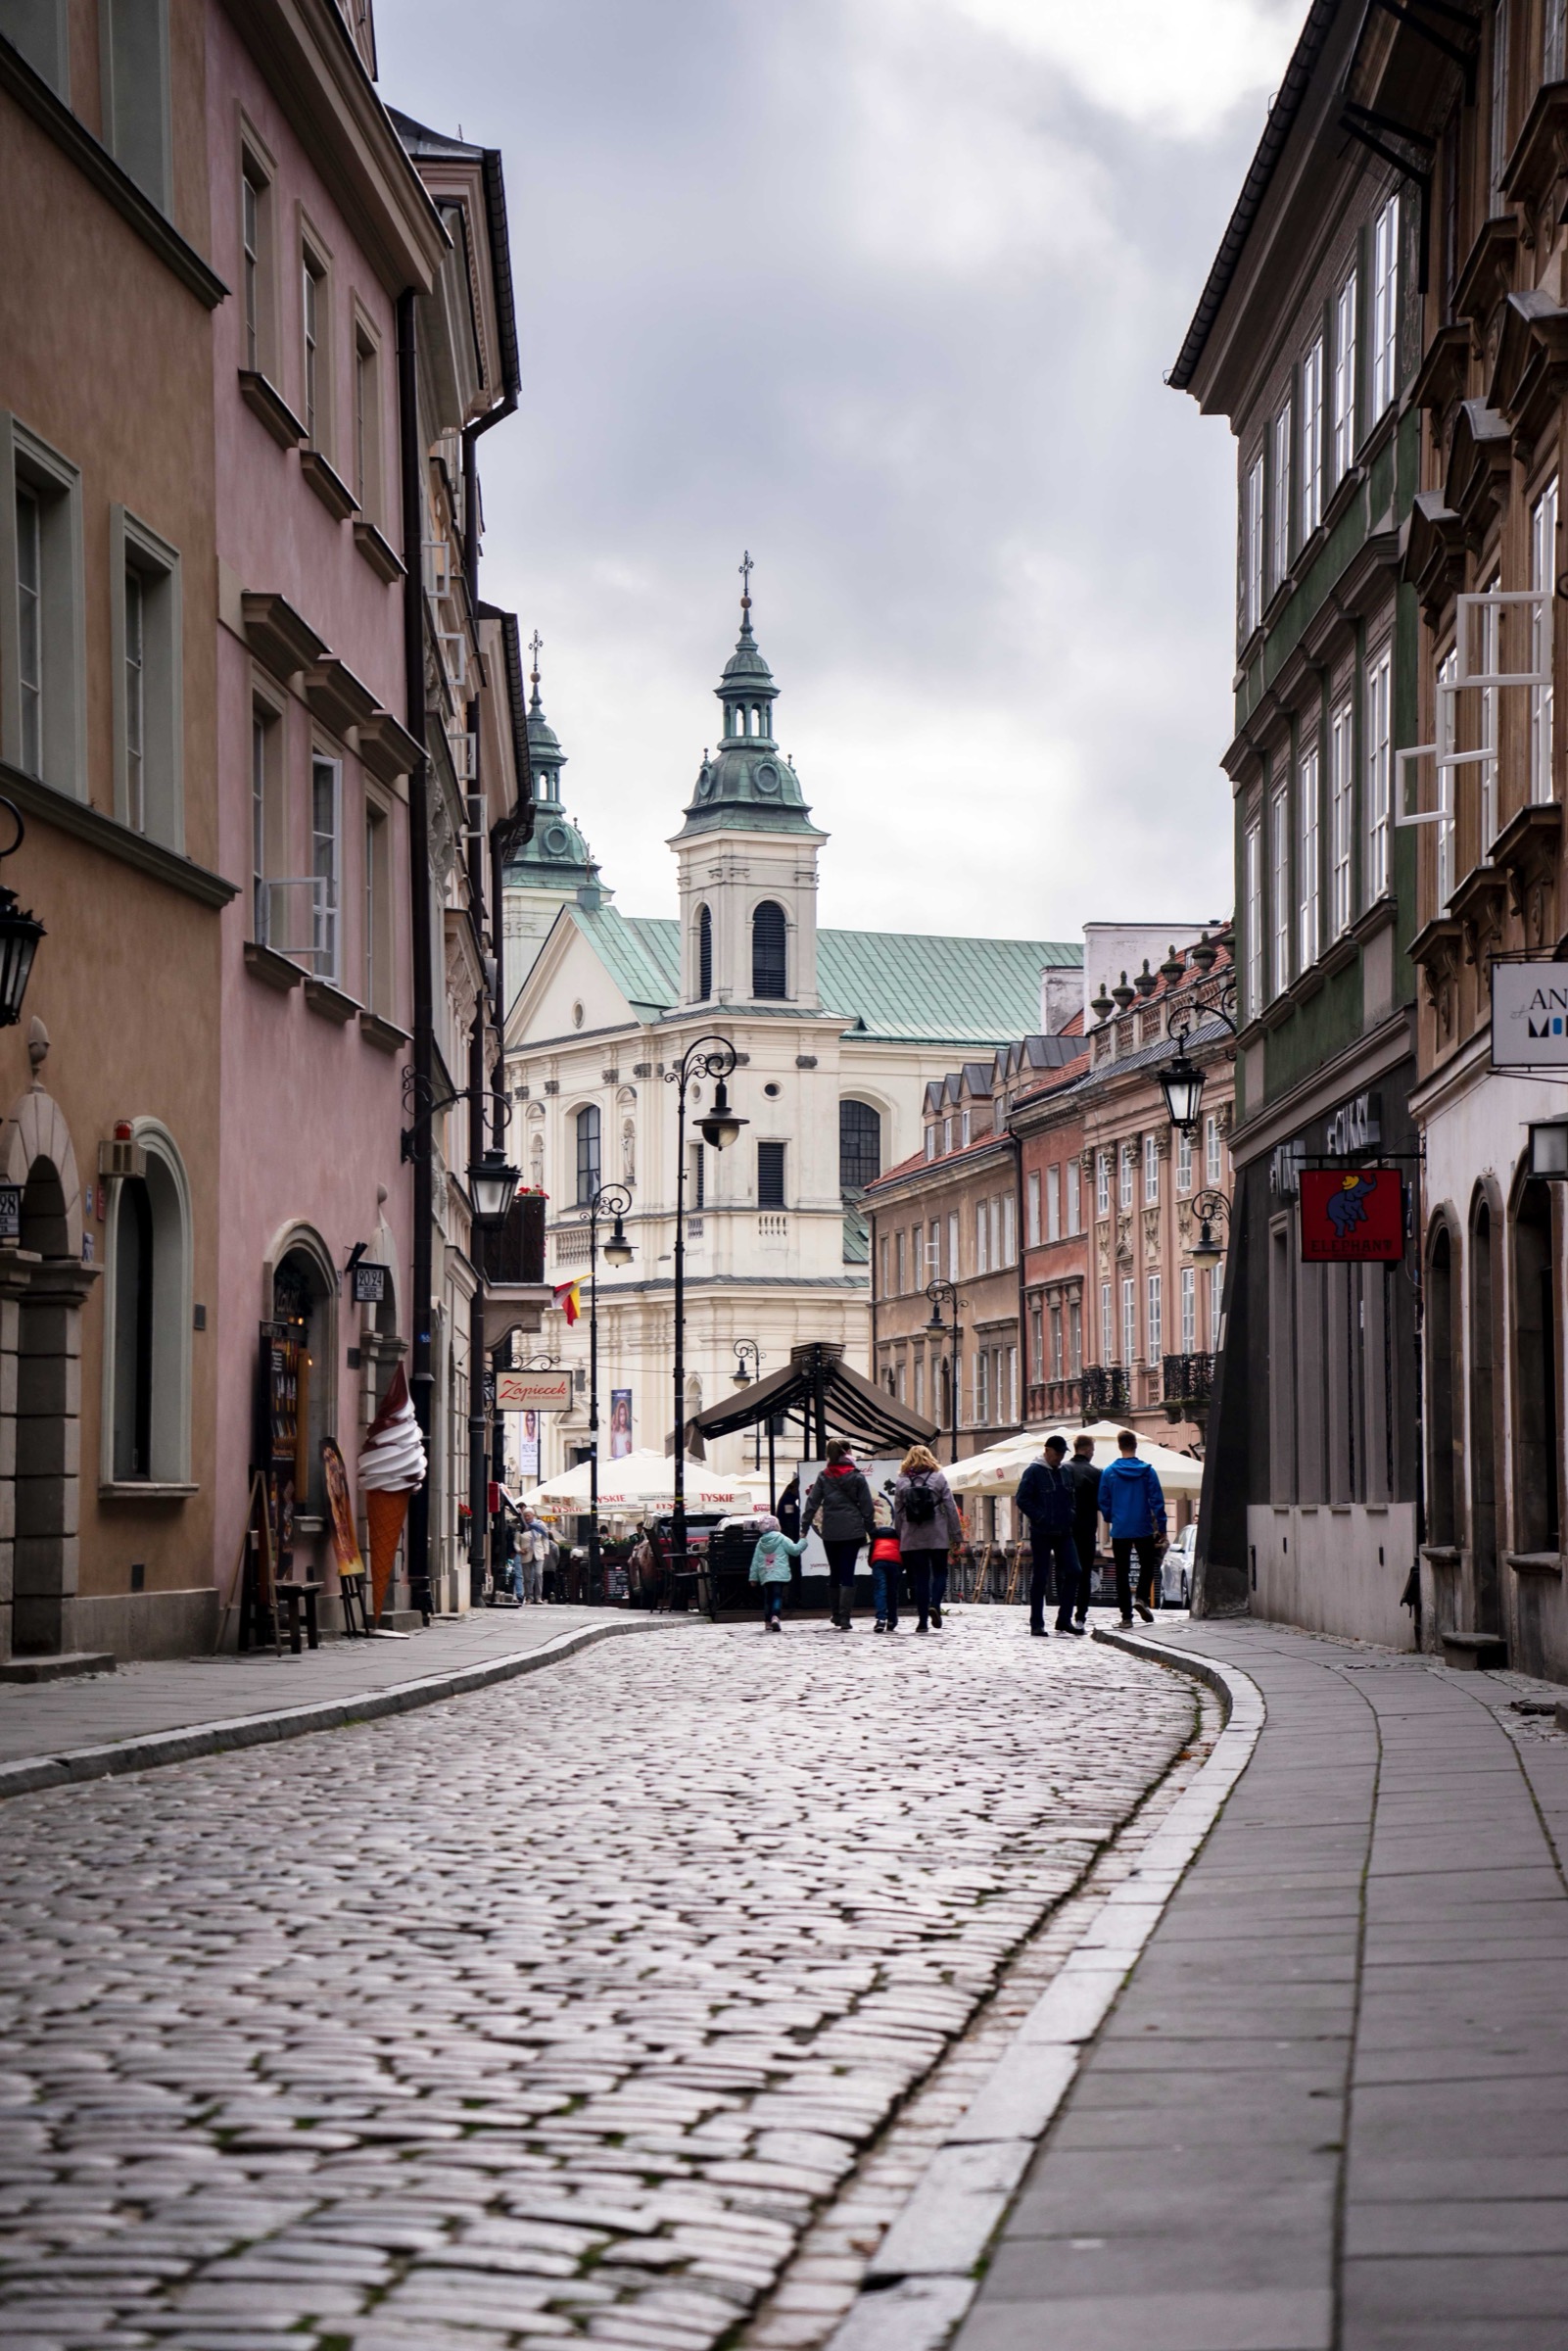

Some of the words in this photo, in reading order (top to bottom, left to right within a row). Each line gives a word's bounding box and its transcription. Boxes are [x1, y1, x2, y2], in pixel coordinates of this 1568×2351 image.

[1529, 1016, 1568, 1038] MO
[1310, 1239, 1392, 1253] ELEPHANT
[499, 1379, 567, 1402] Zapiecek
[595, 1494, 627, 1504] YSKIE
[699, 1493, 736, 1503] TYSKIE
